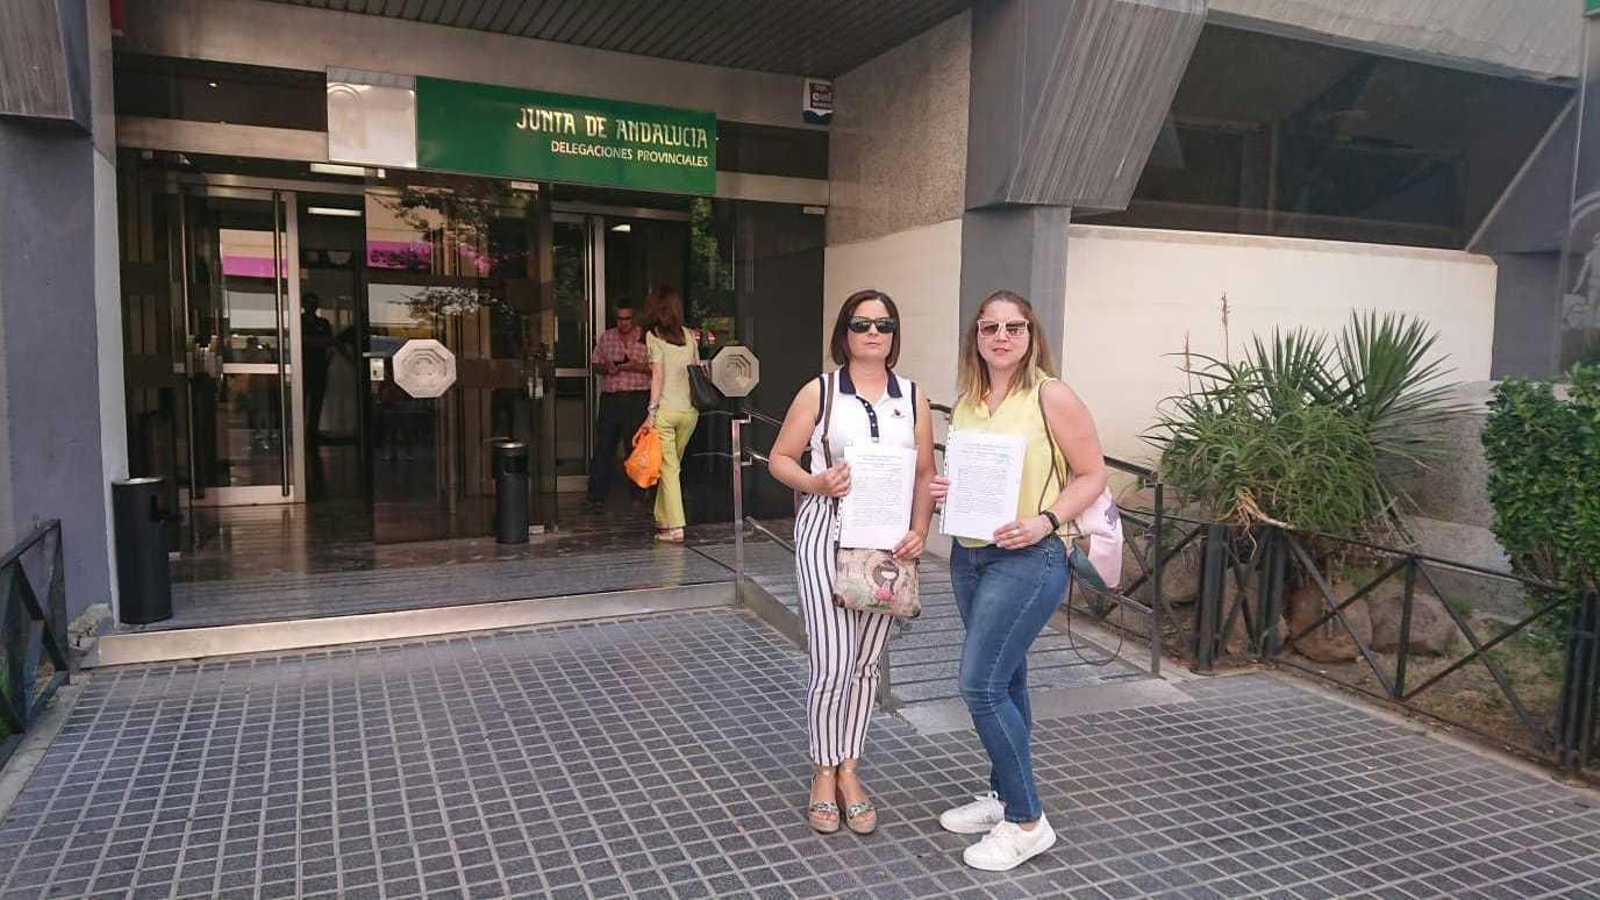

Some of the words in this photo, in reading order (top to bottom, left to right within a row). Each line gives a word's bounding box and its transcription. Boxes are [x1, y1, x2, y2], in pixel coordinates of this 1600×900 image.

[516, 107, 576, 135] JUNTA
[584, 114, 607, 138] DE
[550, 140, 633, 160] DELEGACIONES
[637, 149, 708, 167] PROVINCIALES
